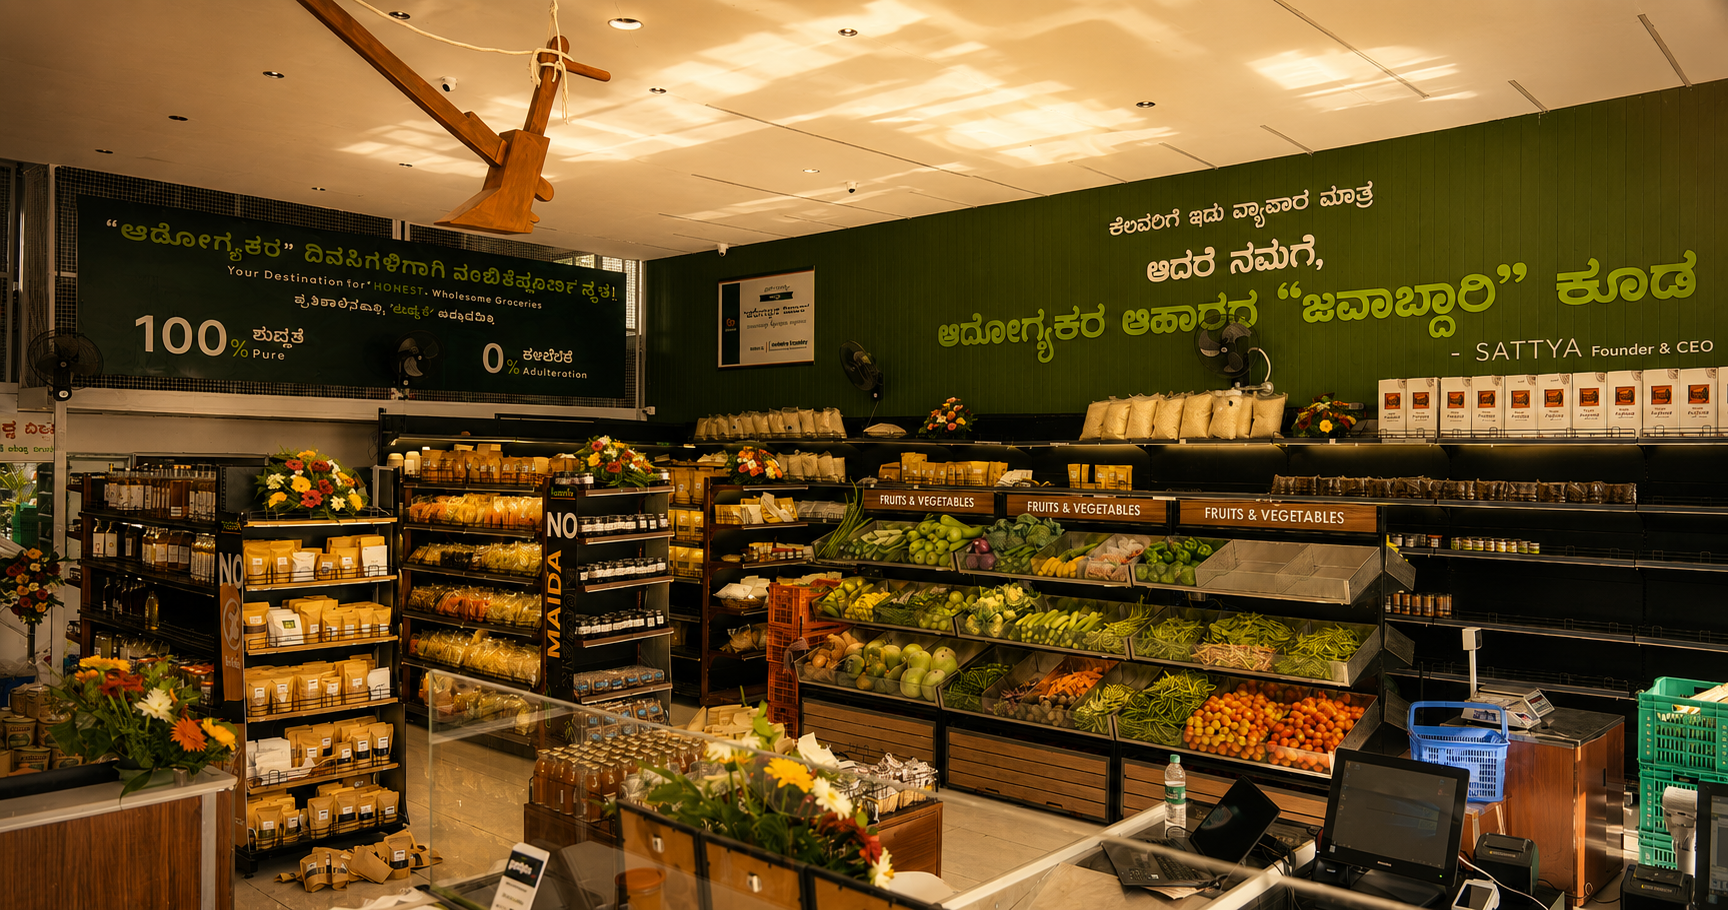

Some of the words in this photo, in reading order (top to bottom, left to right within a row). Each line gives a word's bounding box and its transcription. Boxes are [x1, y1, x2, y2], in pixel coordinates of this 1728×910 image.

[1108, 208, 1181, 237] ಕೆಲವರಿಗೆ
[1232, 189, 1310, 228] ವ್ಯಾಪಾರ
[1318, 180, 1374, 208] ಮಾತ್ರ
[1146, 246, 1216, 283] ಆದರೆ
[1229, 233, 1325, 275] ನಮಗೆ,
[227, 265, 259, 278] Your
[264, 269, 343, 286] Destination
[431, 288, 492, 304] Wholesome
[495, 296, 542, 310] Groceries
[1276, 262, 1528, 338] “ಜವಾಬ್ದಾರಿ”
[1555, 249, 1698, 306] ಕೂಡ
[252, 348, 285, 361] Pure
[1475, 337, 1583, 363] SATTYA
[1591, 343, 1655, 358] Founder
[1659, 341, 1671, 355] &
[1676, 339, 1715, 354] CEO
[522, 367, 588, 379] Adulteration
[879, 494, 907, 506] FRUITS
[908, 495, 915, 506] &
[917, 495, 975, 508] VEGETABLES
[1027, 501, 1059, 513] FRUITS
[1062, 502, 1071, 514] &
[1073, 502, 1141, 516] VEGETABLES
[1204, 507, 1244, 520] FRUITS
[1248, 509, 1258, 521] &
[1261, 509, 1345, 524] VEGETABLES
[547, 511, 578, 540] NO
[218, 551, 244, 590] NO
[547, 549, 562, 659] MAIDA
